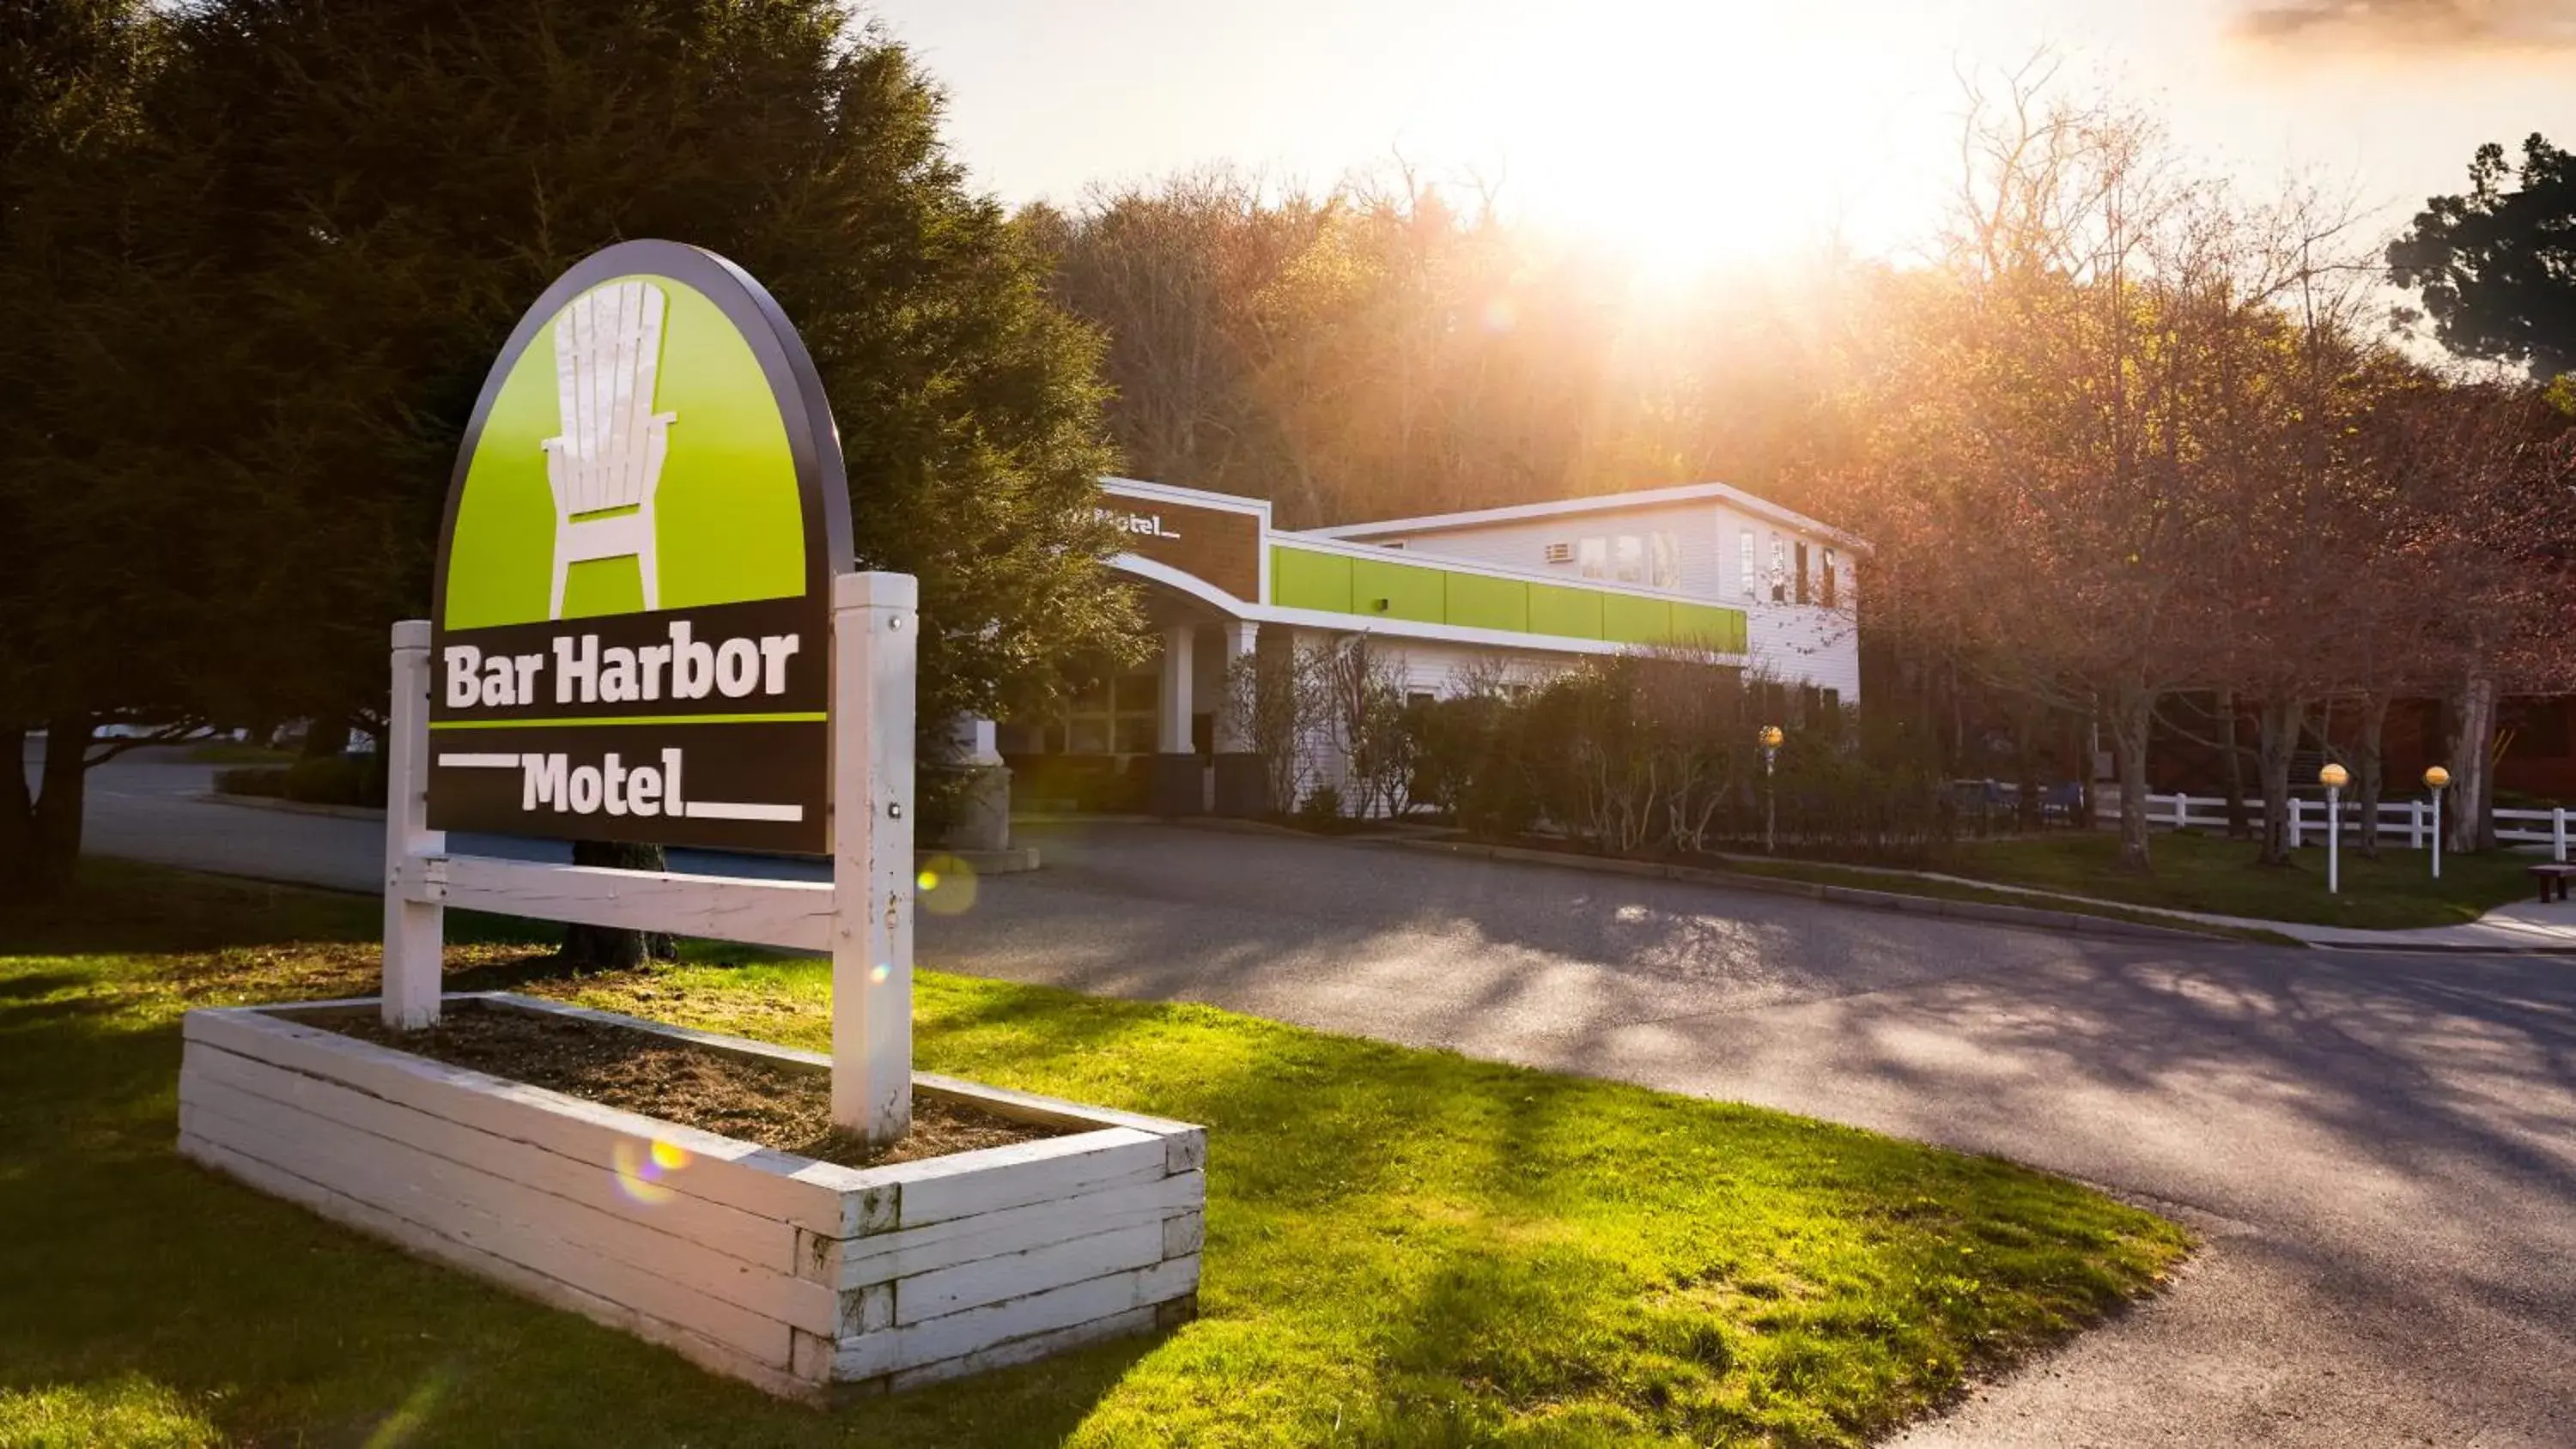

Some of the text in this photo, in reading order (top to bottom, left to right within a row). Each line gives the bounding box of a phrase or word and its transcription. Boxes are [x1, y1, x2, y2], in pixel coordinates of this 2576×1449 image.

[444, 621, 799, 707] Bar Harbor
[521, 748, 684, 816] Motel
